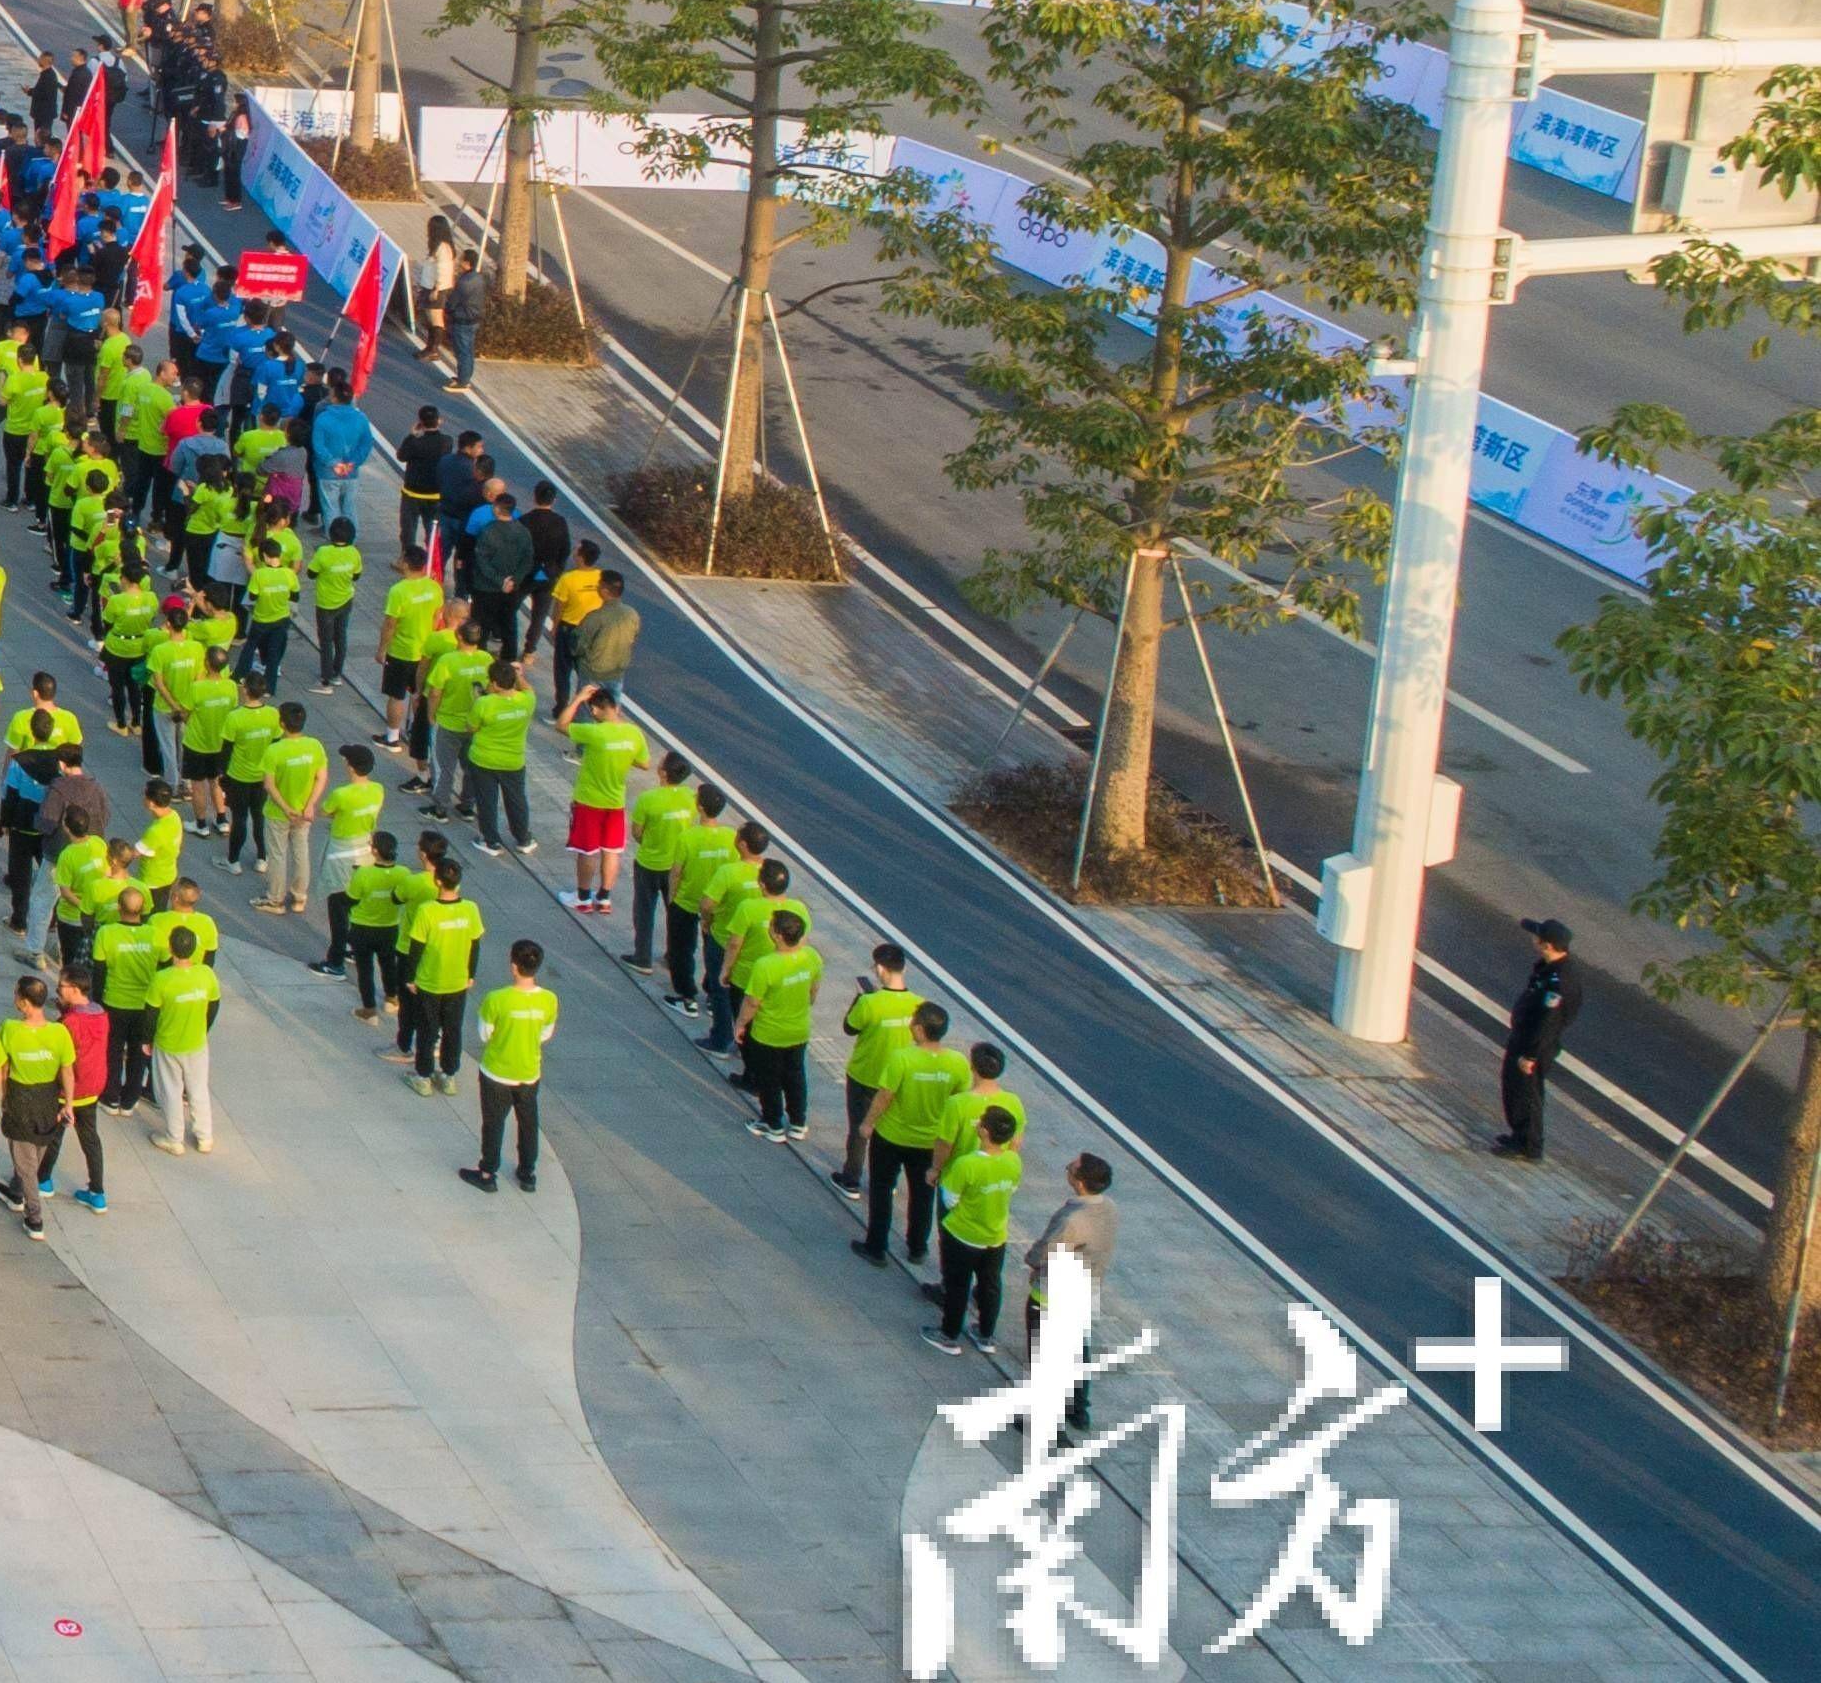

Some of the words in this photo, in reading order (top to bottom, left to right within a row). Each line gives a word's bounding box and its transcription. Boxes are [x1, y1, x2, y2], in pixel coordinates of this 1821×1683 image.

[1533, 112, 1620, 158] 滨海湾新区
[1101, 246, 1165, 292] 滨海湾新
[57, 1622, 79, 1635] 62
